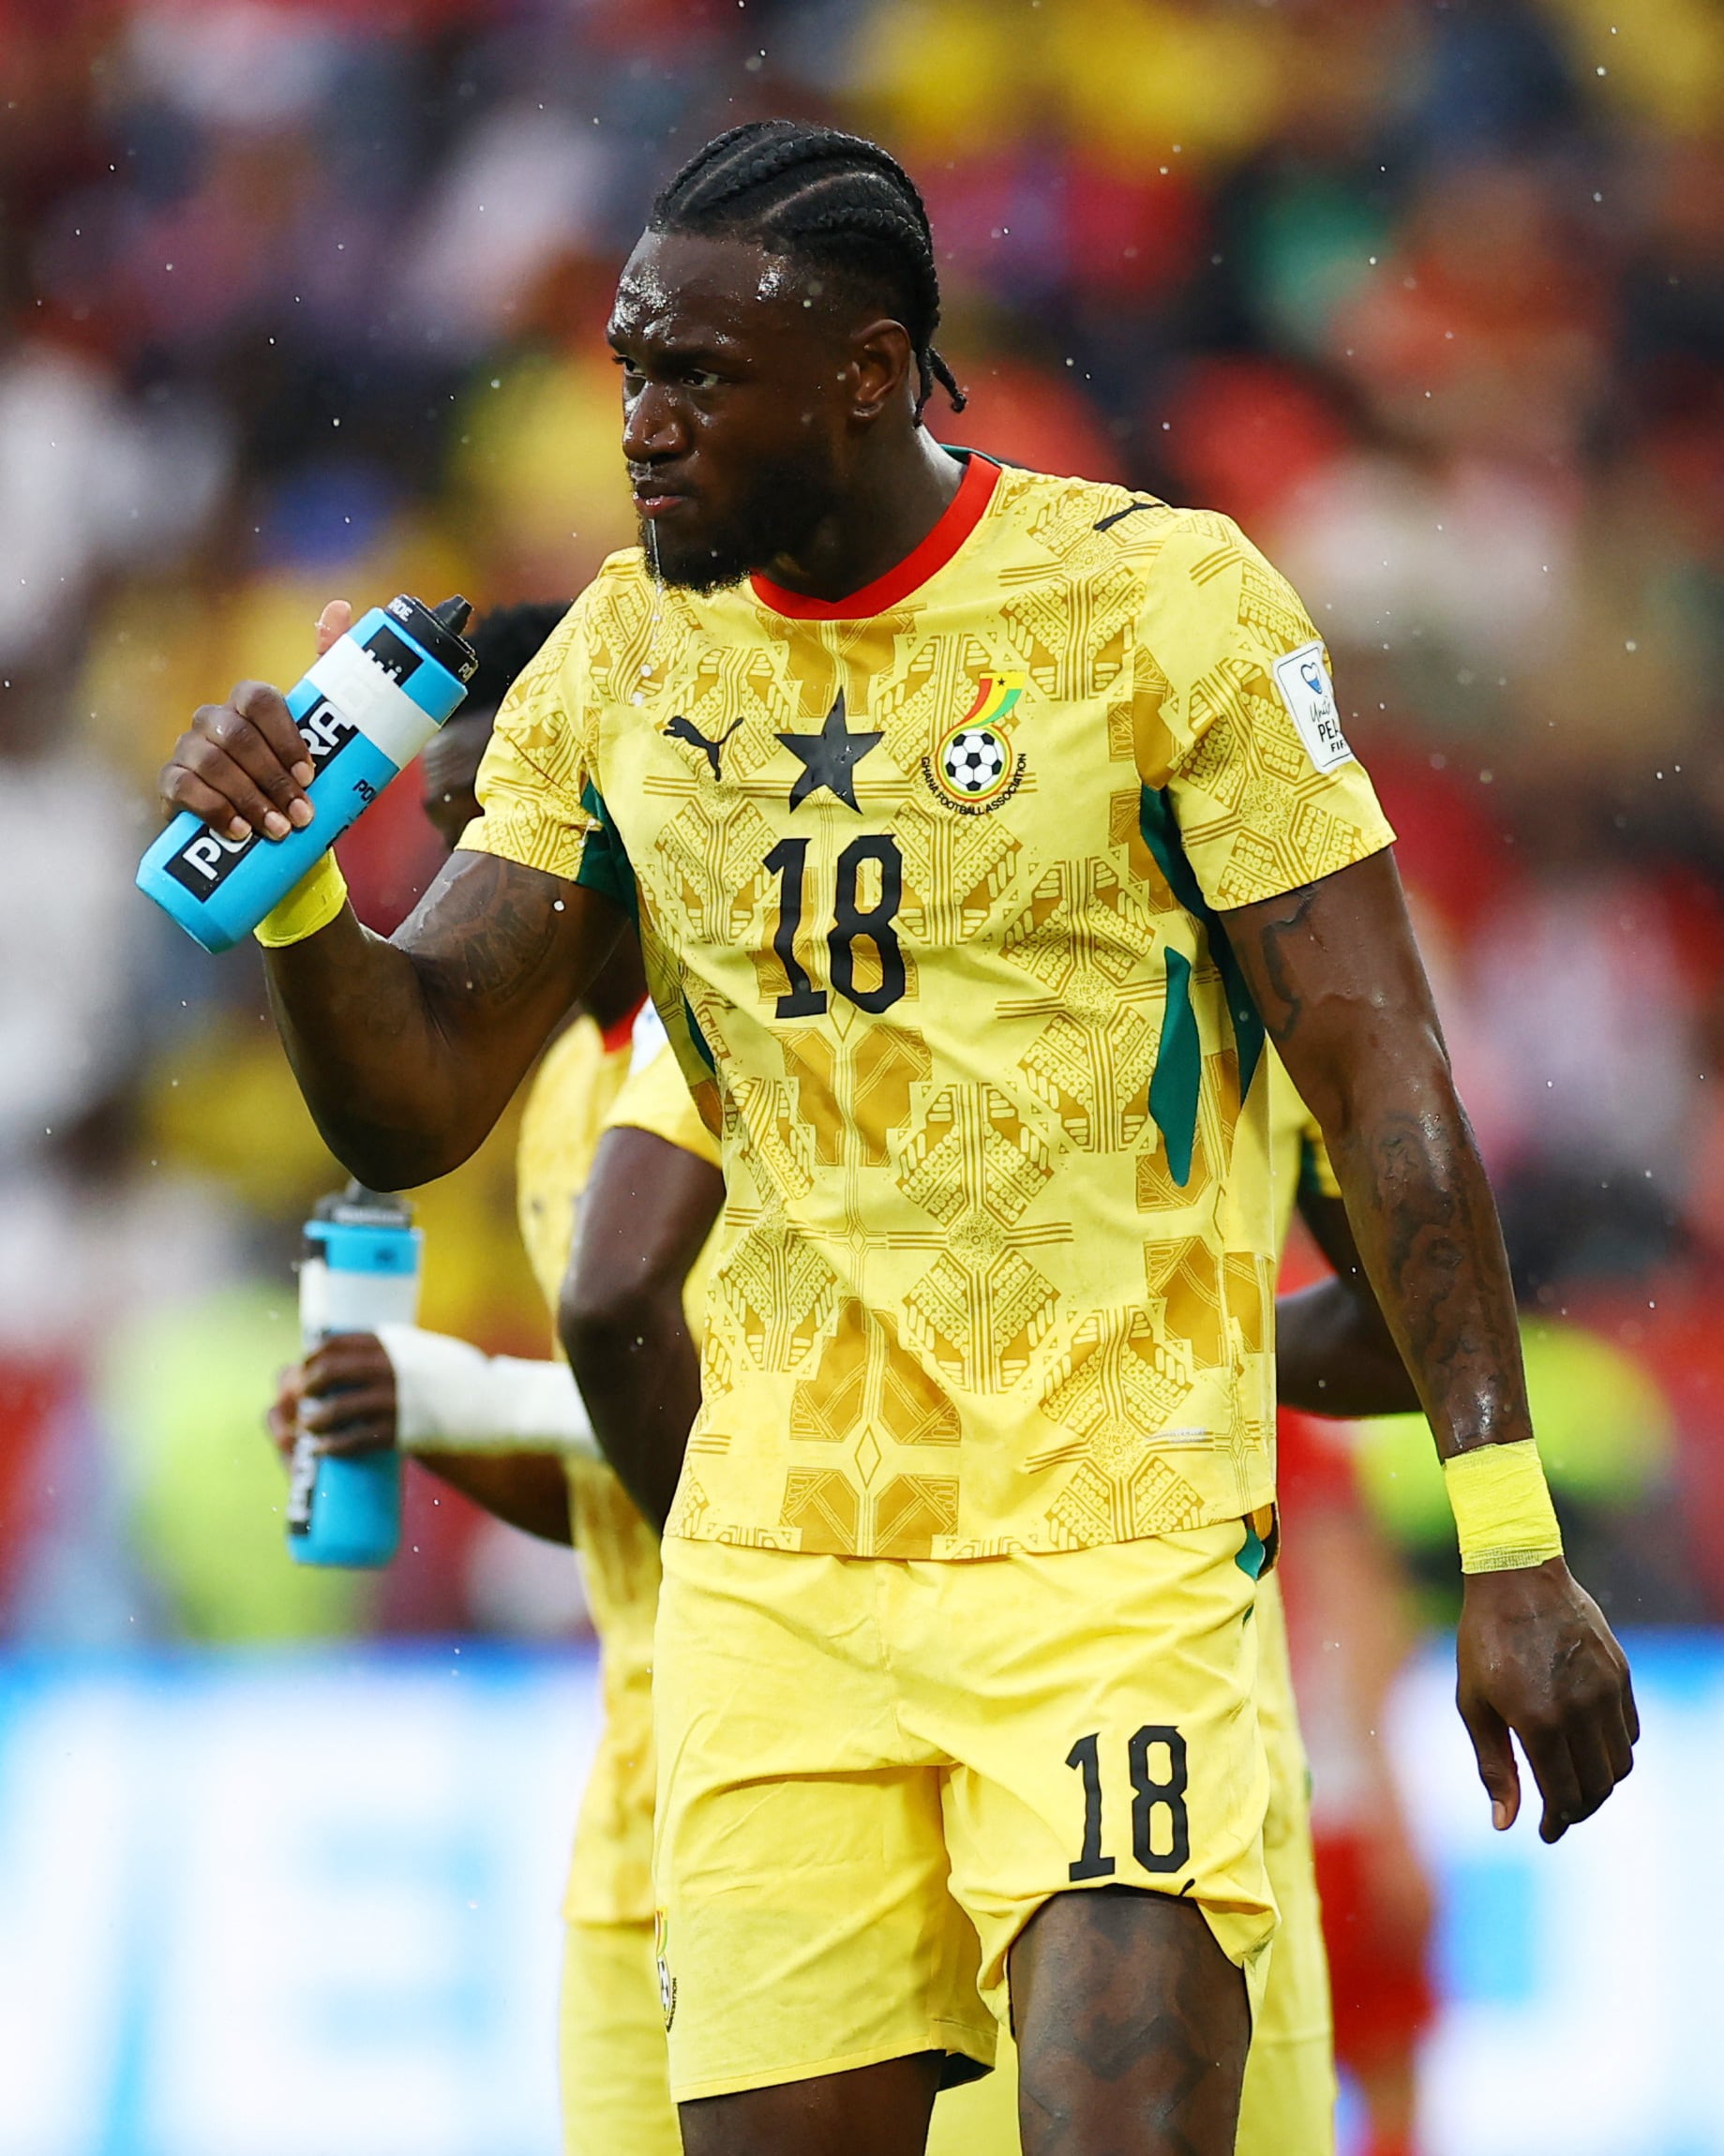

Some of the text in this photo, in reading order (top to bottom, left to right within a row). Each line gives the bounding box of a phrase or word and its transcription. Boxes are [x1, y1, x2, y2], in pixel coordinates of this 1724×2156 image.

[921, 753, 1027, 816] GHANA FOOTBALL ASSOCIATION
[761, 833, 907, 1020] 18
[1065, 1725, 1191, 1882] 18
